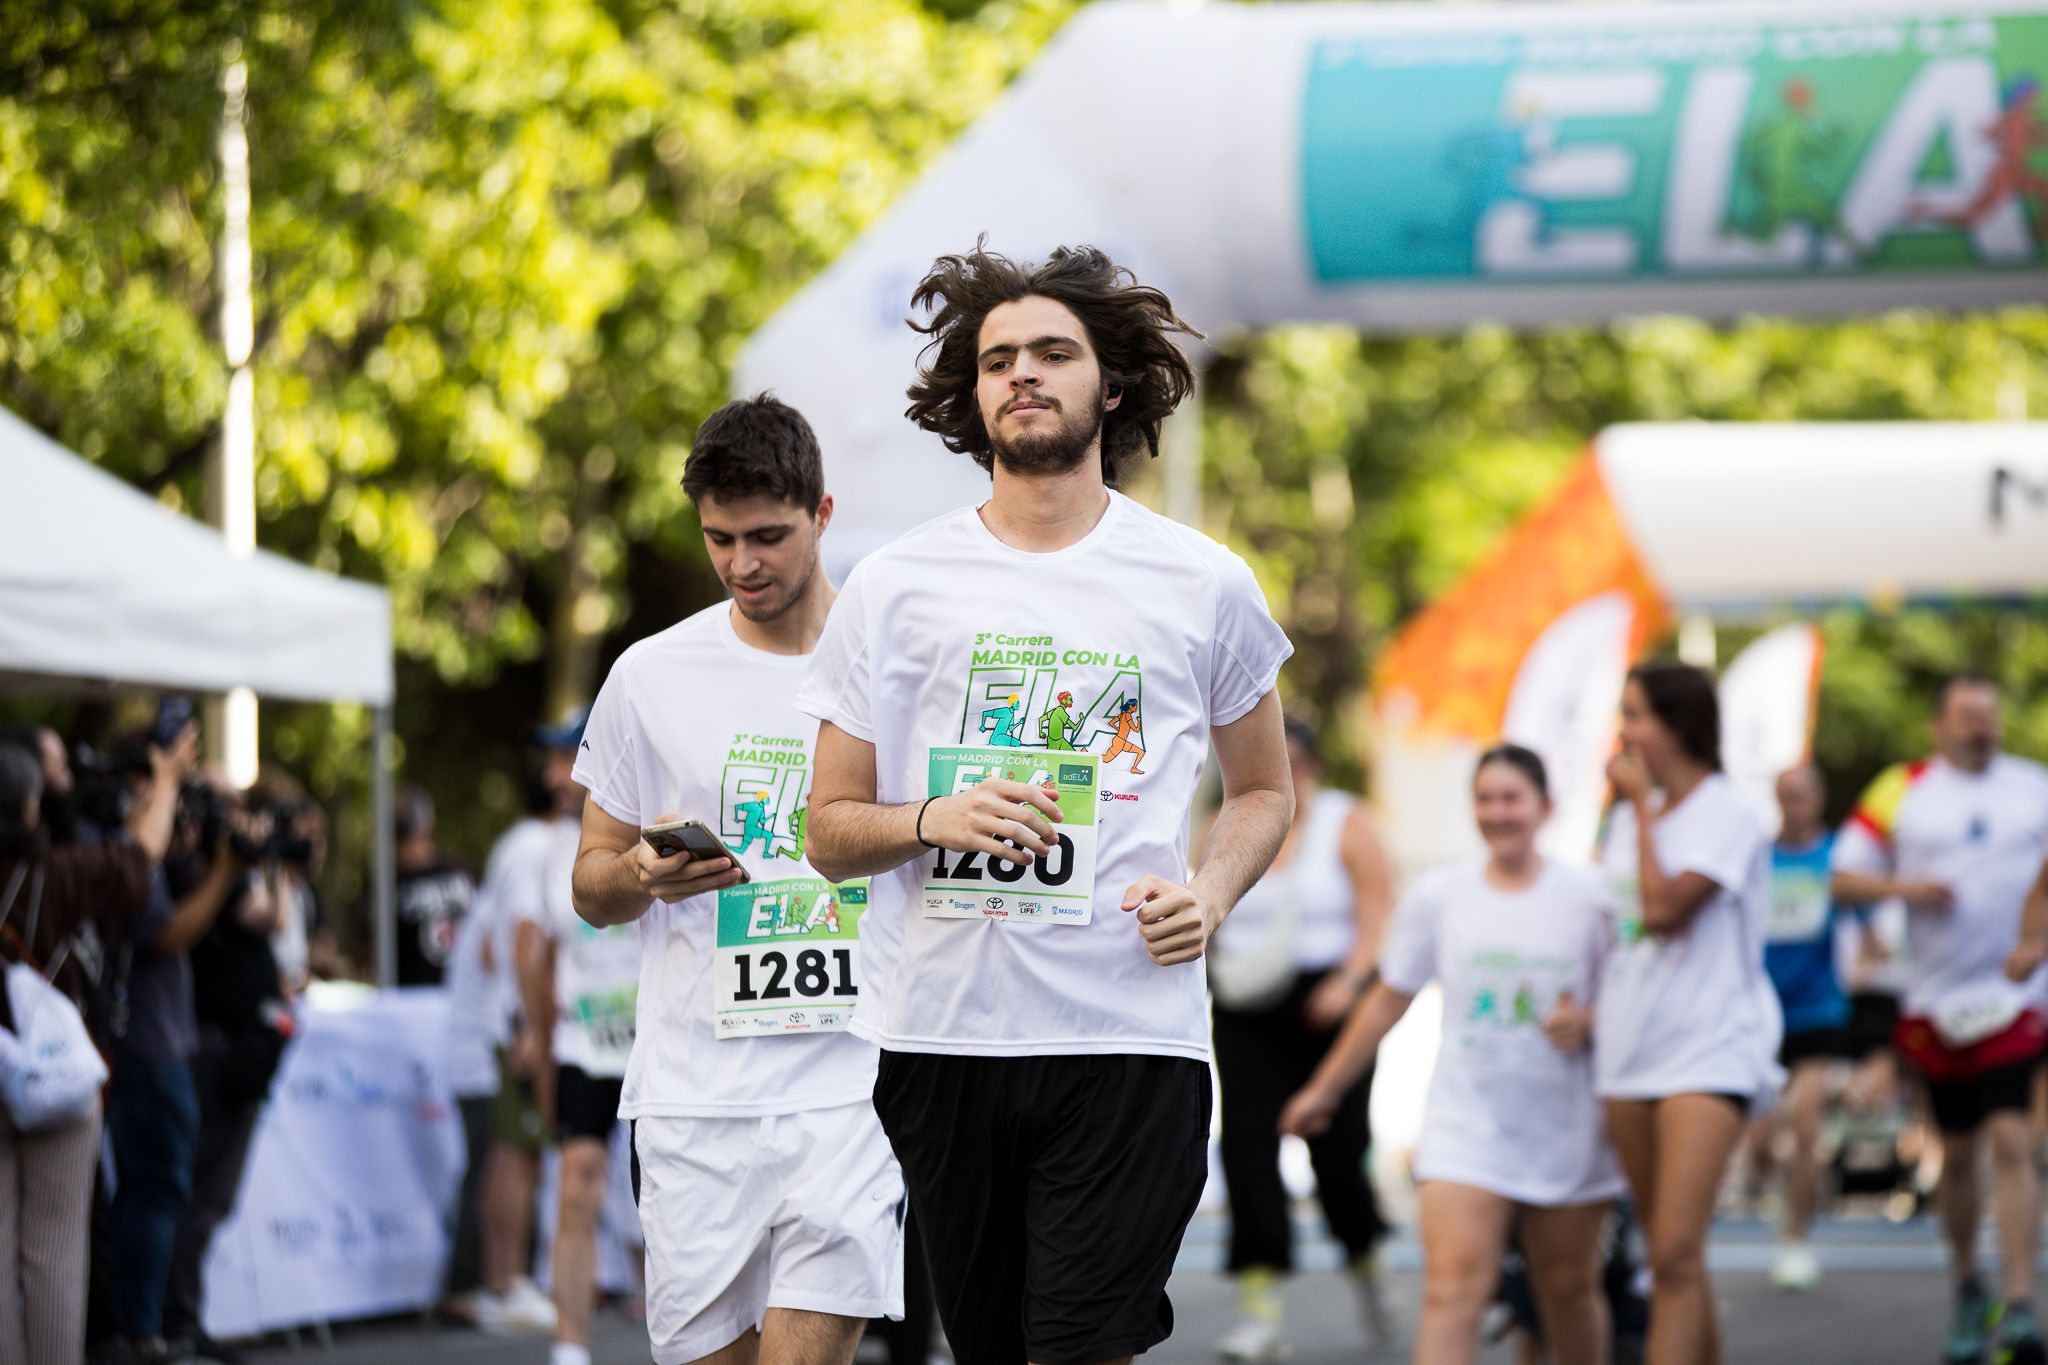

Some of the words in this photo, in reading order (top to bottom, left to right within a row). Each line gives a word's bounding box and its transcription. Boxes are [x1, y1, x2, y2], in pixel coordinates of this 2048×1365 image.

[1476, 57, 2037, 271] ELA
[996, 633, 1054, 646] Carrera
[972, 650, 1057, 666] MADRID
[1062, 650, 1109, 666] CON
[1113, 653, 1140, 669] LA
[752, 735, 804, 747] Carrera
[727, 749, 807, 766] MADRID
[958, 754, 1004, 764] MADRID
[1007, 756, 1030, 766] CON
[1034, 758, 1048, 767] LA
[754, 885, 789, 896] MADRID
[792, 883, 814, 891] CON
[816, 883, 829, 891] LA
[954, 901, 975, 910] Biogen
[746, 893, 840, 938] ELA
[734, 949, 858, 1002] 1281
